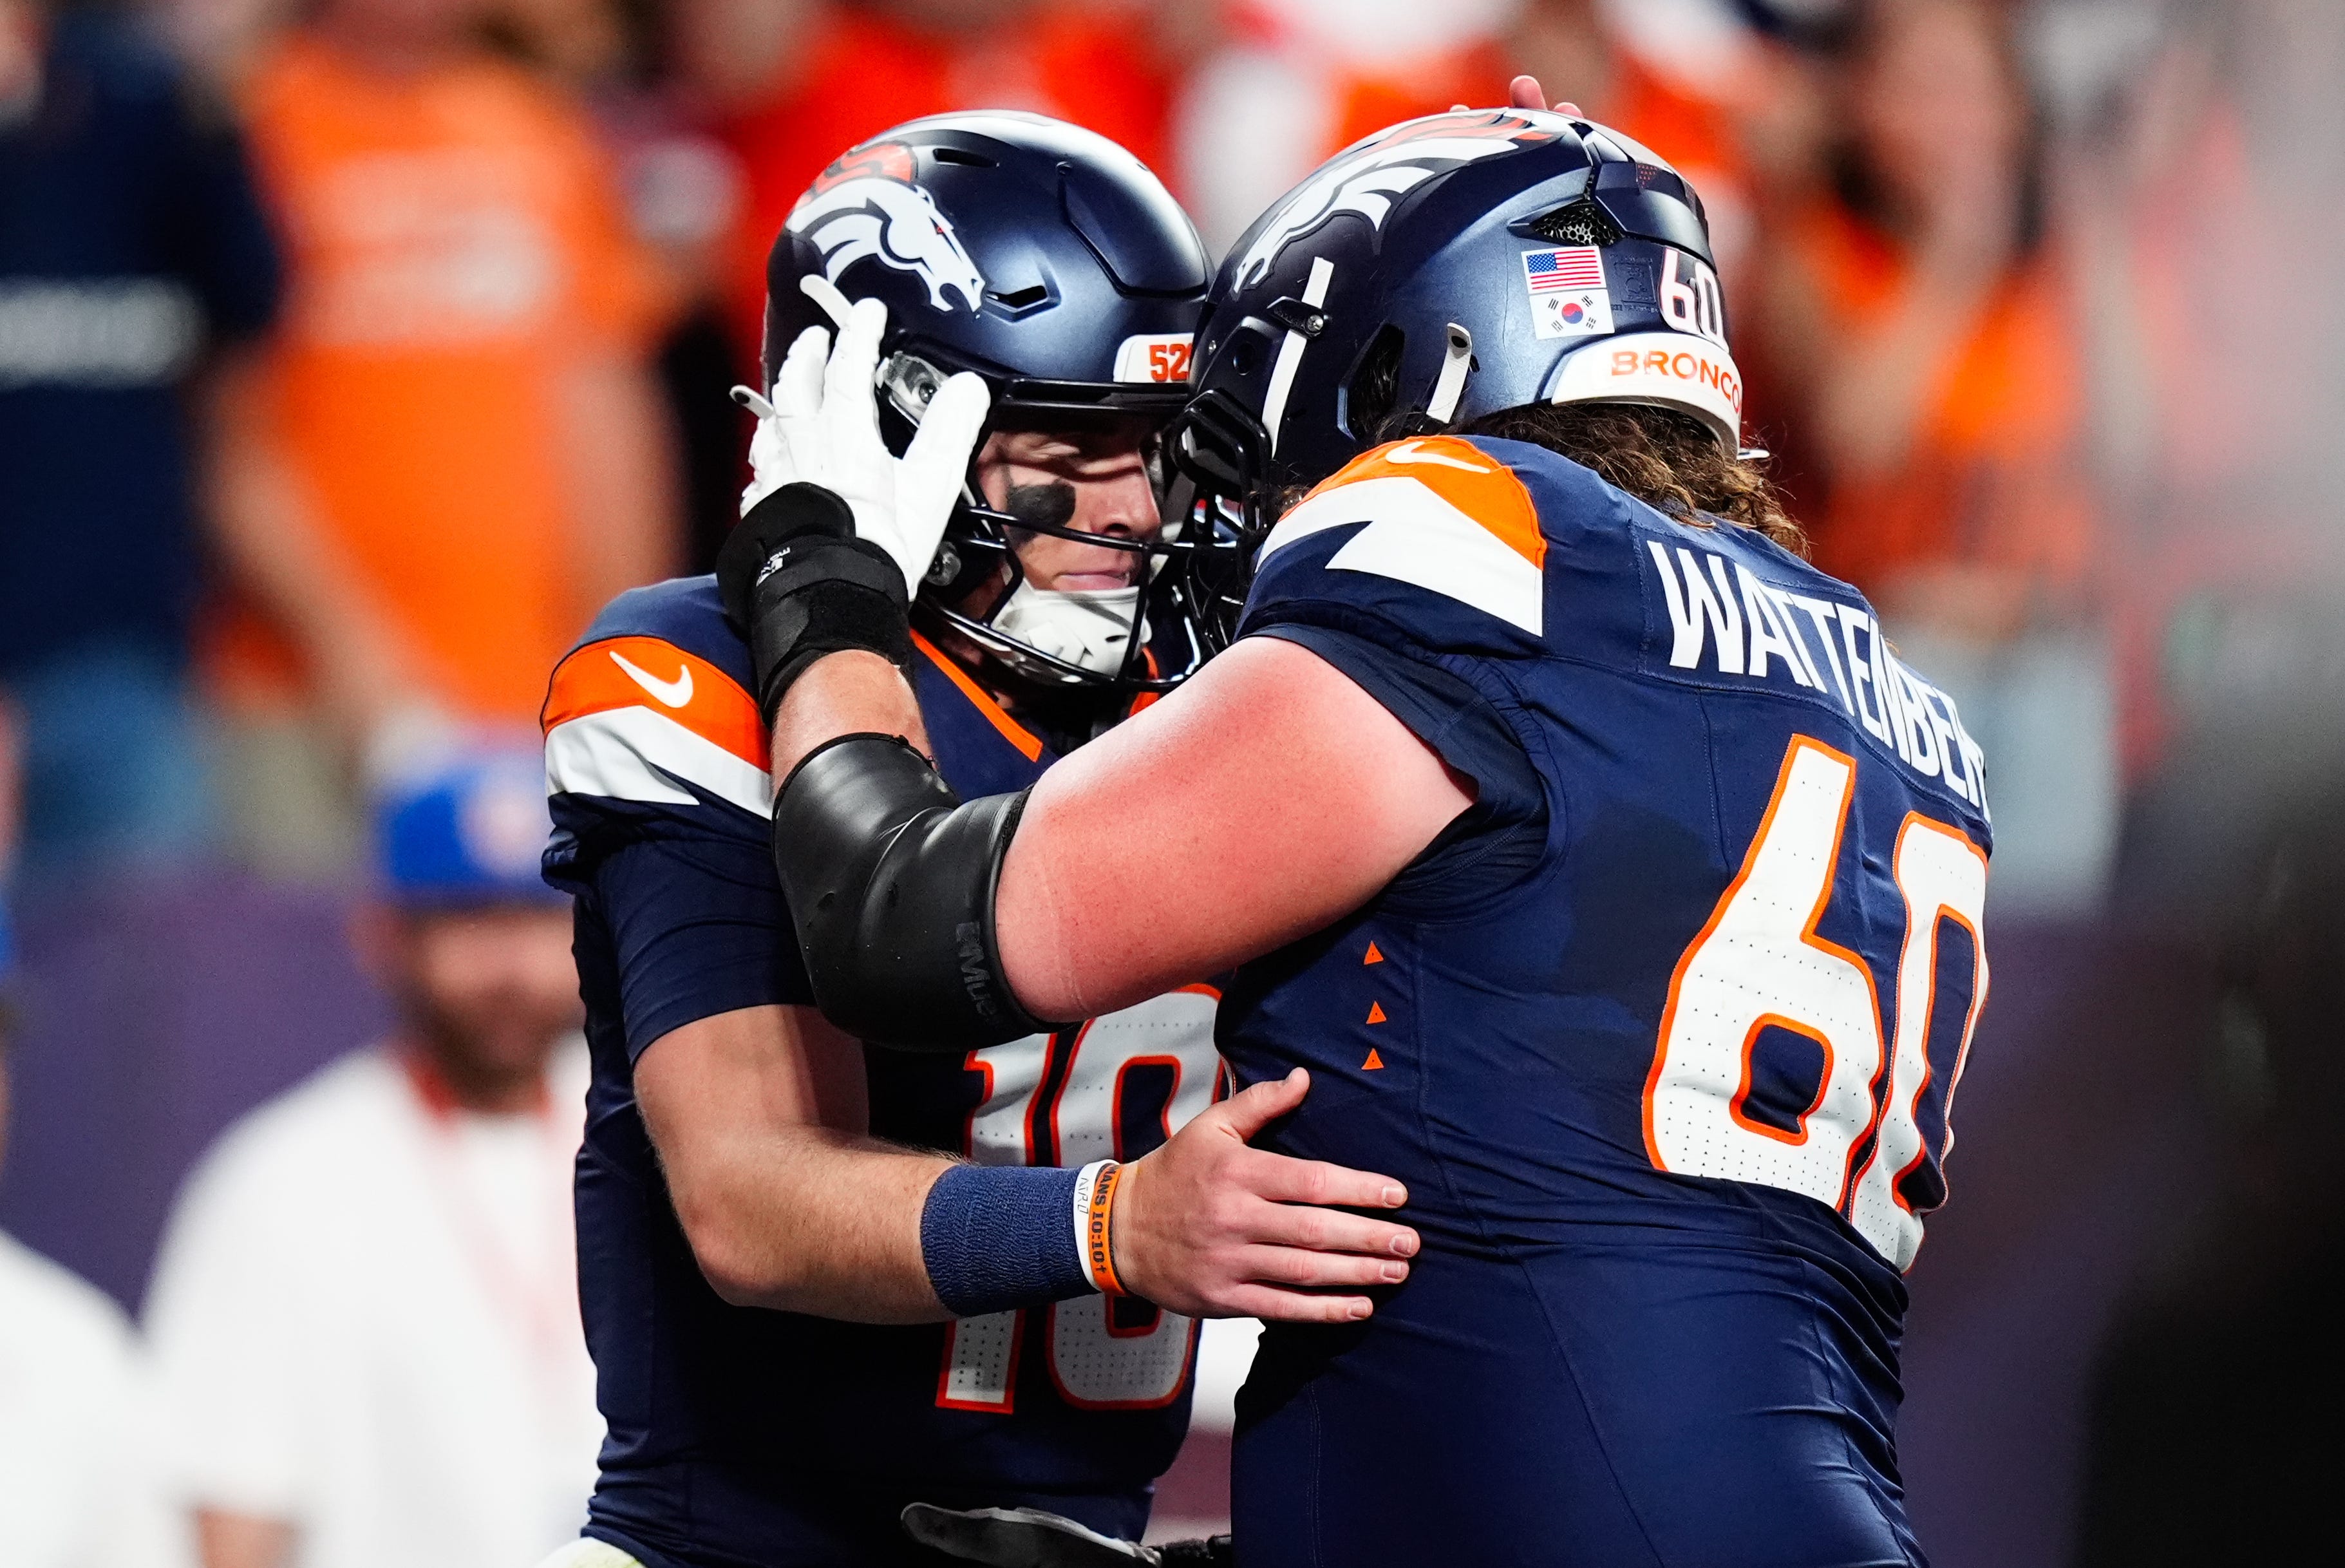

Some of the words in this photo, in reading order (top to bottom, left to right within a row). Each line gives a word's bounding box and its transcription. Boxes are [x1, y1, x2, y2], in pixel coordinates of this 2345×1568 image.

[1149, 343, 1192, 383] 52
[1659, 246, 1731, 355] 60
[1642, 733, 1990, 1275] 60
[935, 983, 1223, 1415] 10
